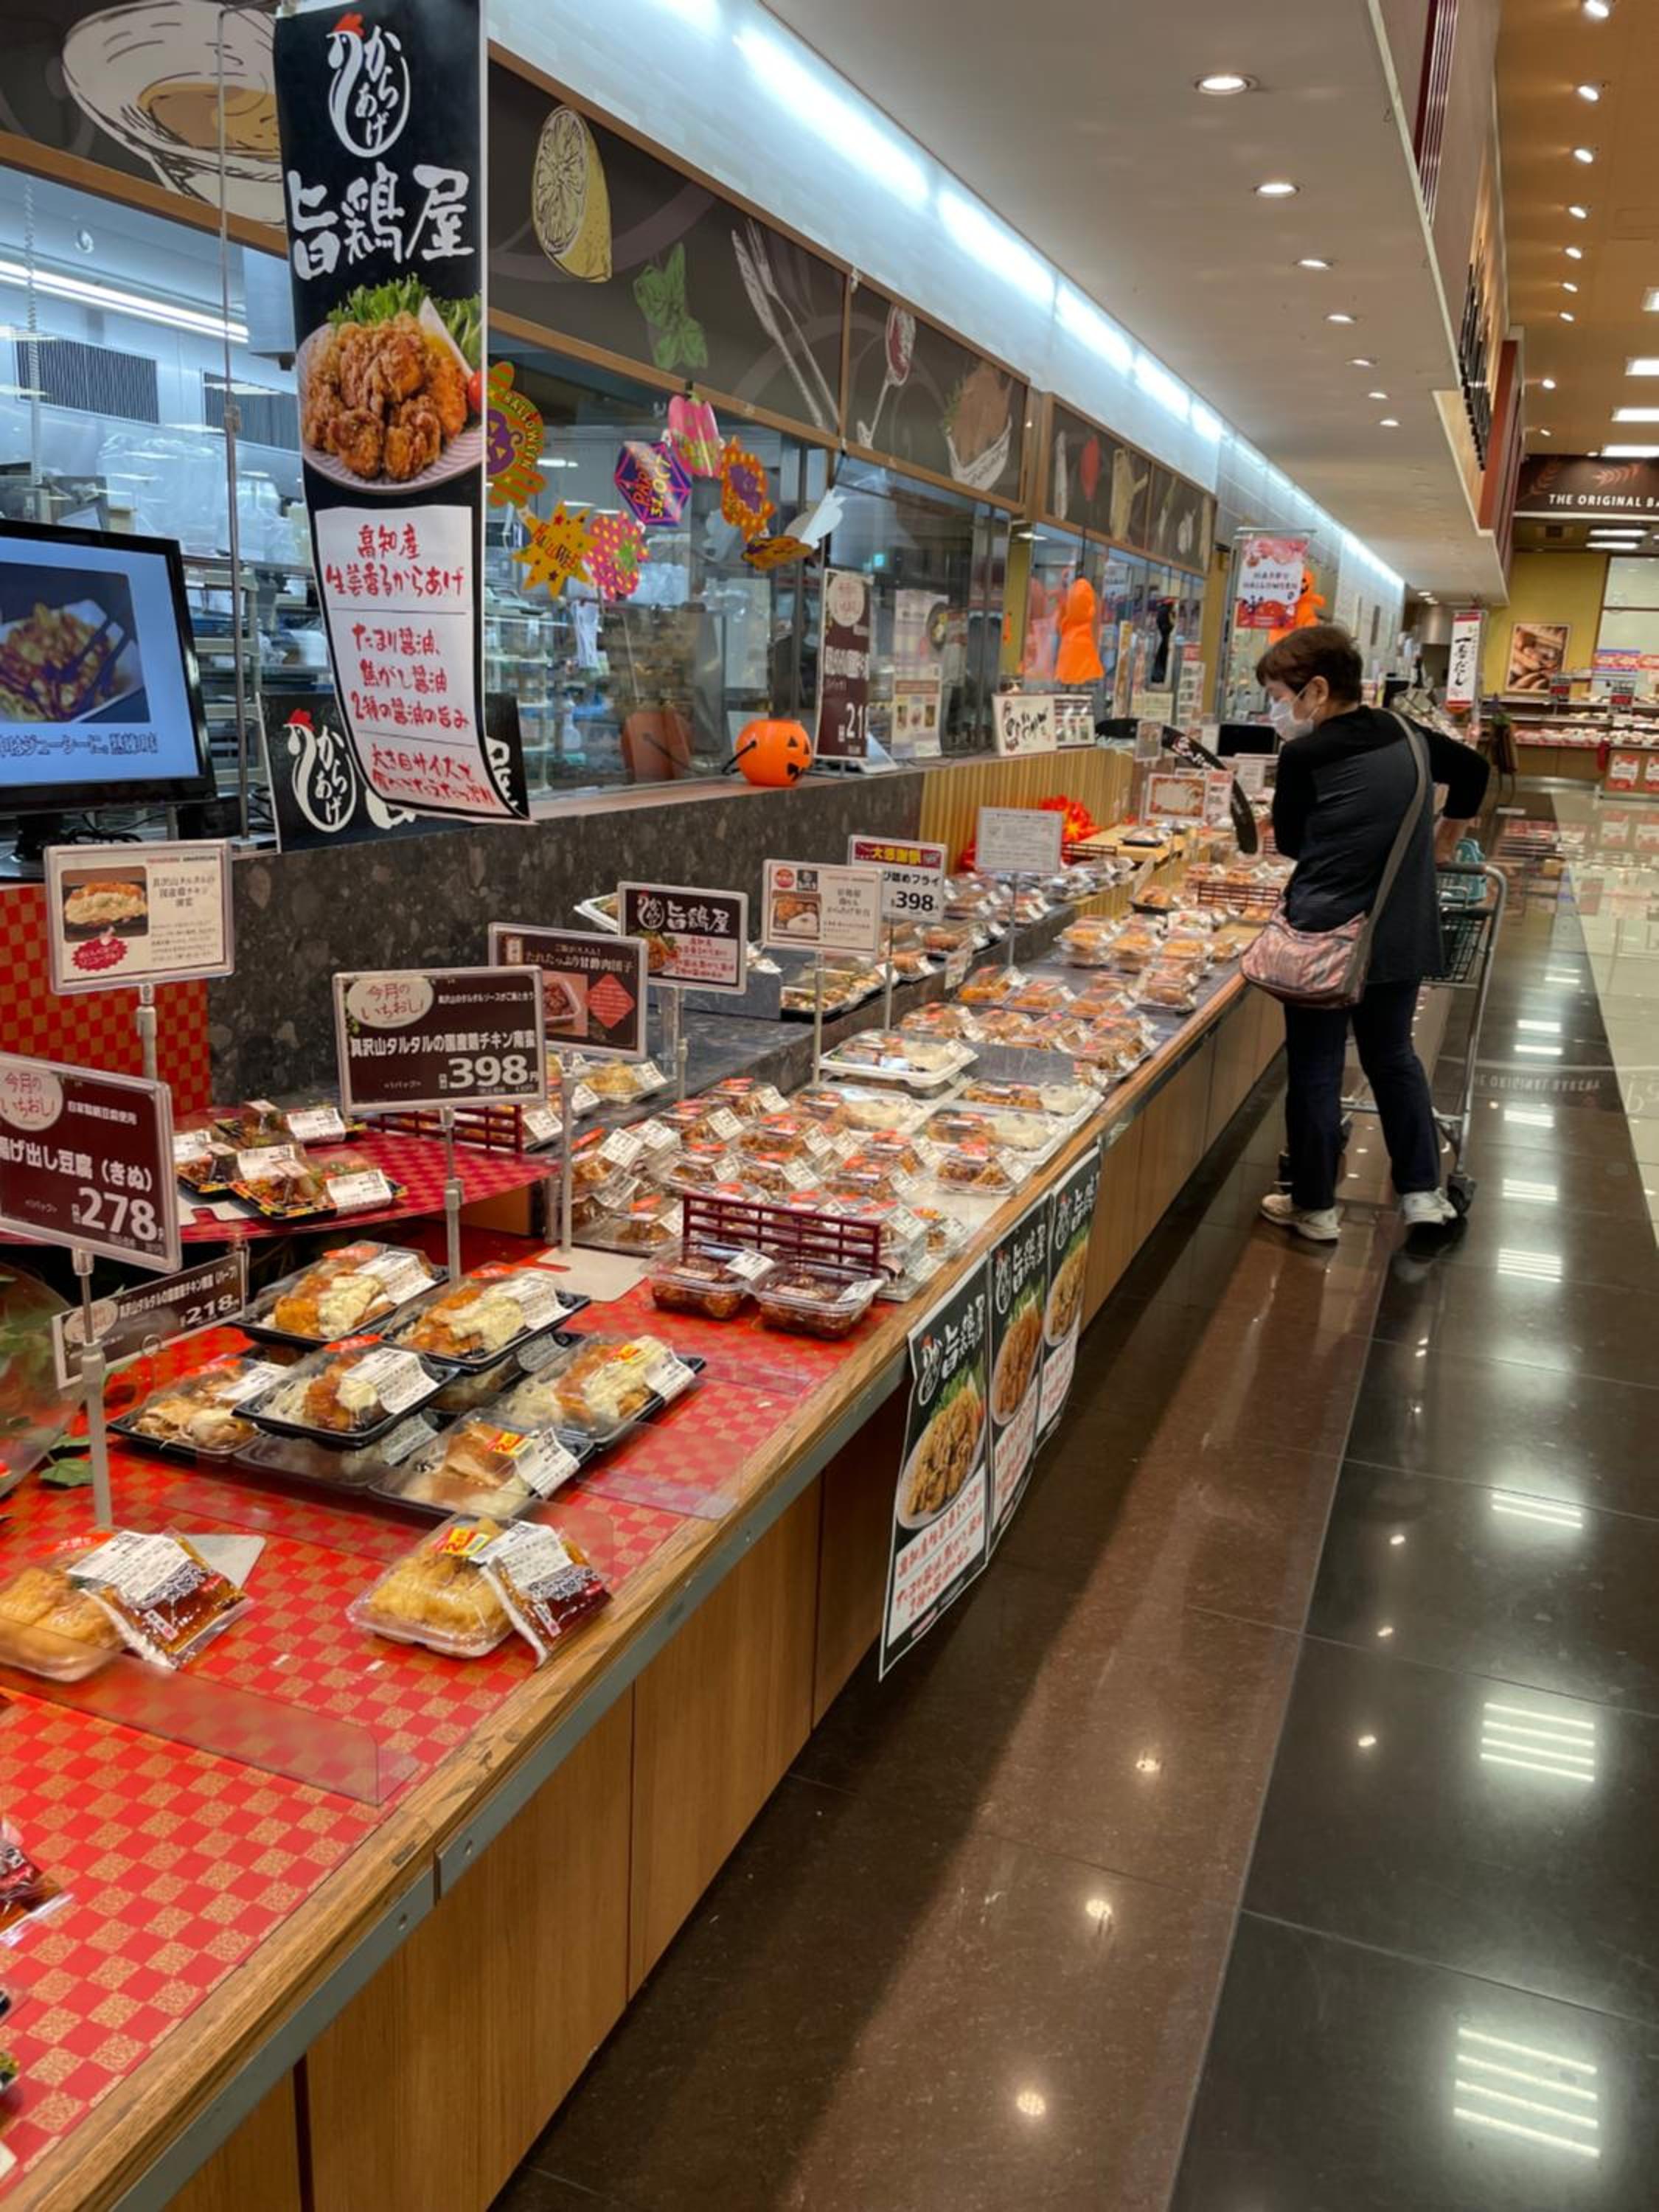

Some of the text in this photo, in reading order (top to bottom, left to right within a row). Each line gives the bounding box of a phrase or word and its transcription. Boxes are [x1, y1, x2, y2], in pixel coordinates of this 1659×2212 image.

[356, 24, 403, 147] からあげ
[287, 161, 475, 280] 旨鶏屋
[1549, 494, 1573, 505] THE
[1577, 495, 1642, 507] ORIGINAL
[358, 524, 421, 560] 高知産
[314, 725, 349, 824] からあげ
[667, 900, 731, 933] 旨鶏屋
[896, 890, 934, 912] 398
[448, 1054, 528, 1088] 398
[79, 1187, 158, 1241] 278
[186, 1294, 234, 1325] 218
